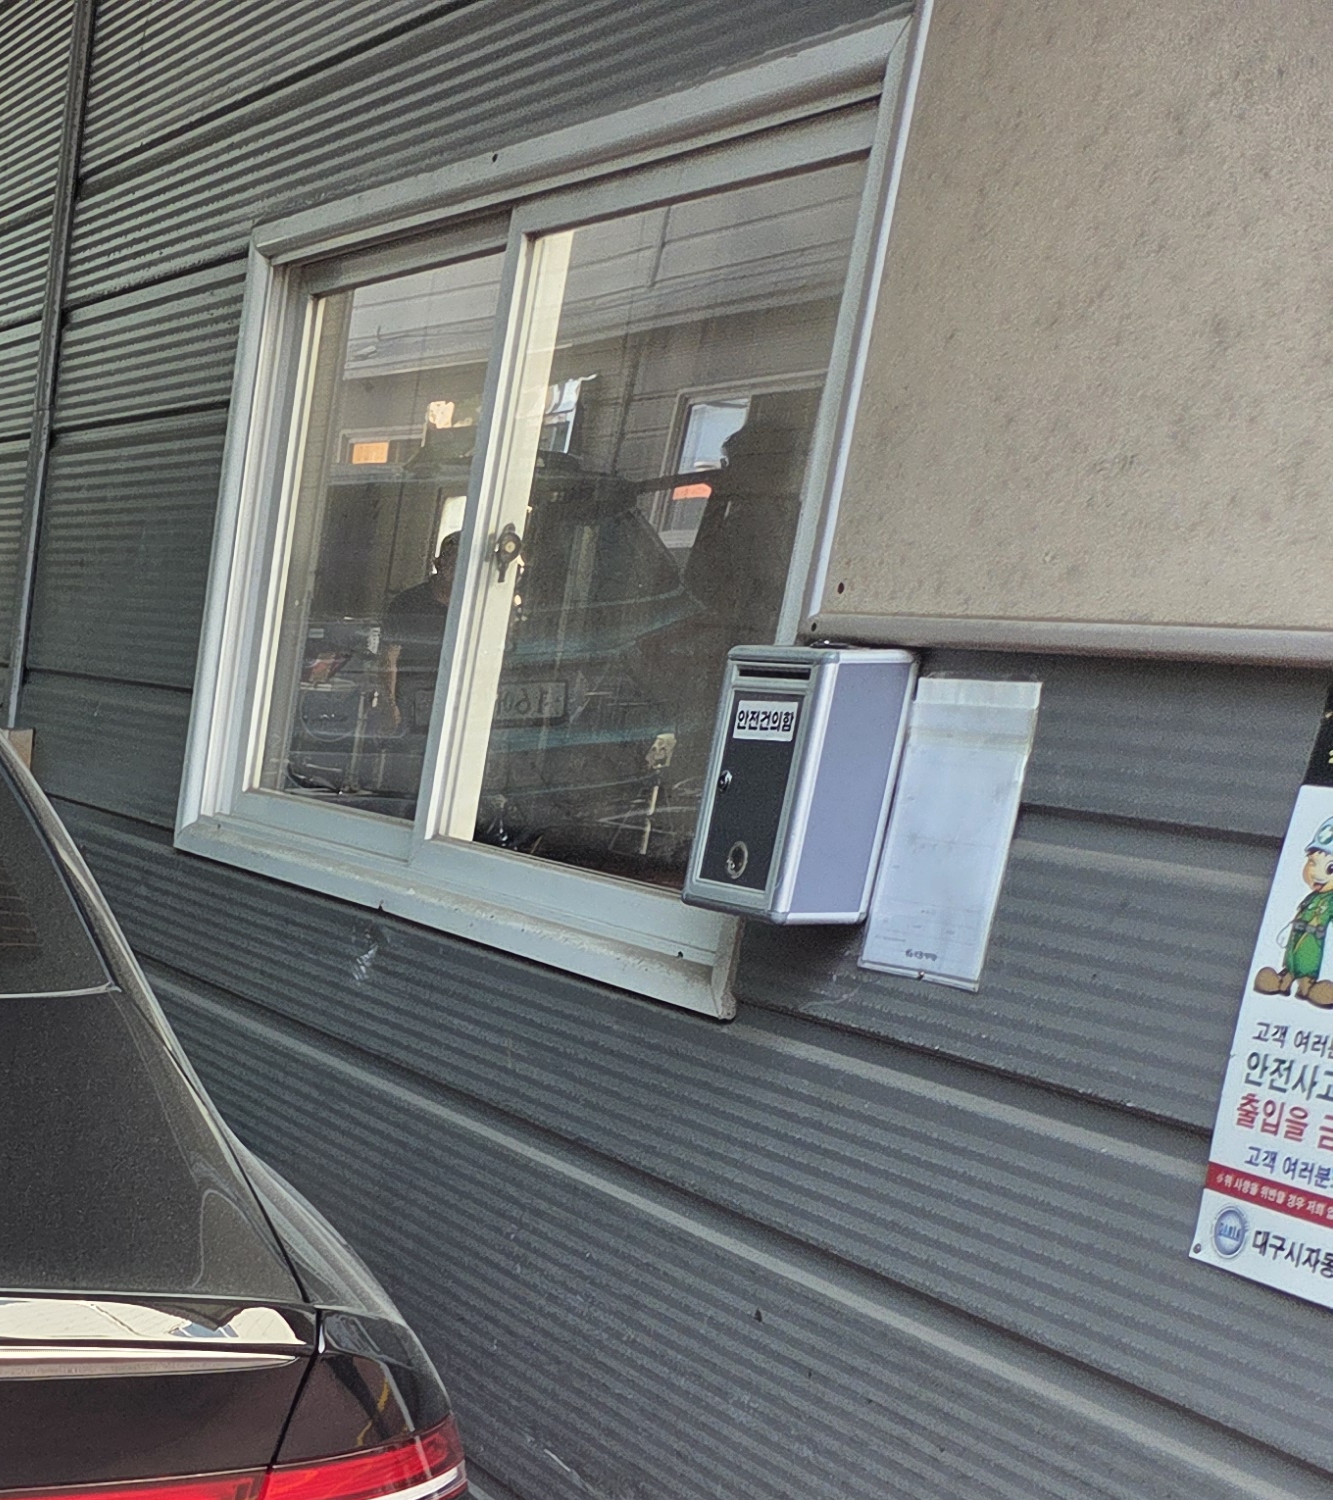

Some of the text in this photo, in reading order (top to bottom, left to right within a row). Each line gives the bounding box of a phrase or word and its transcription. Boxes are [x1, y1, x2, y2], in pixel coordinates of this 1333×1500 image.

[736, 709, 795, 732] 안전건의함
[1251, 1021, 1290, 1049] 고객
[1244, 1051, 1333, 1102] 안전사고
[1236, 1092, 1309, 1143] 출입을
[1244, 1145, 1333, 1189] 고객 여러분
[1286, 1193, 1306, 1210] 경우
